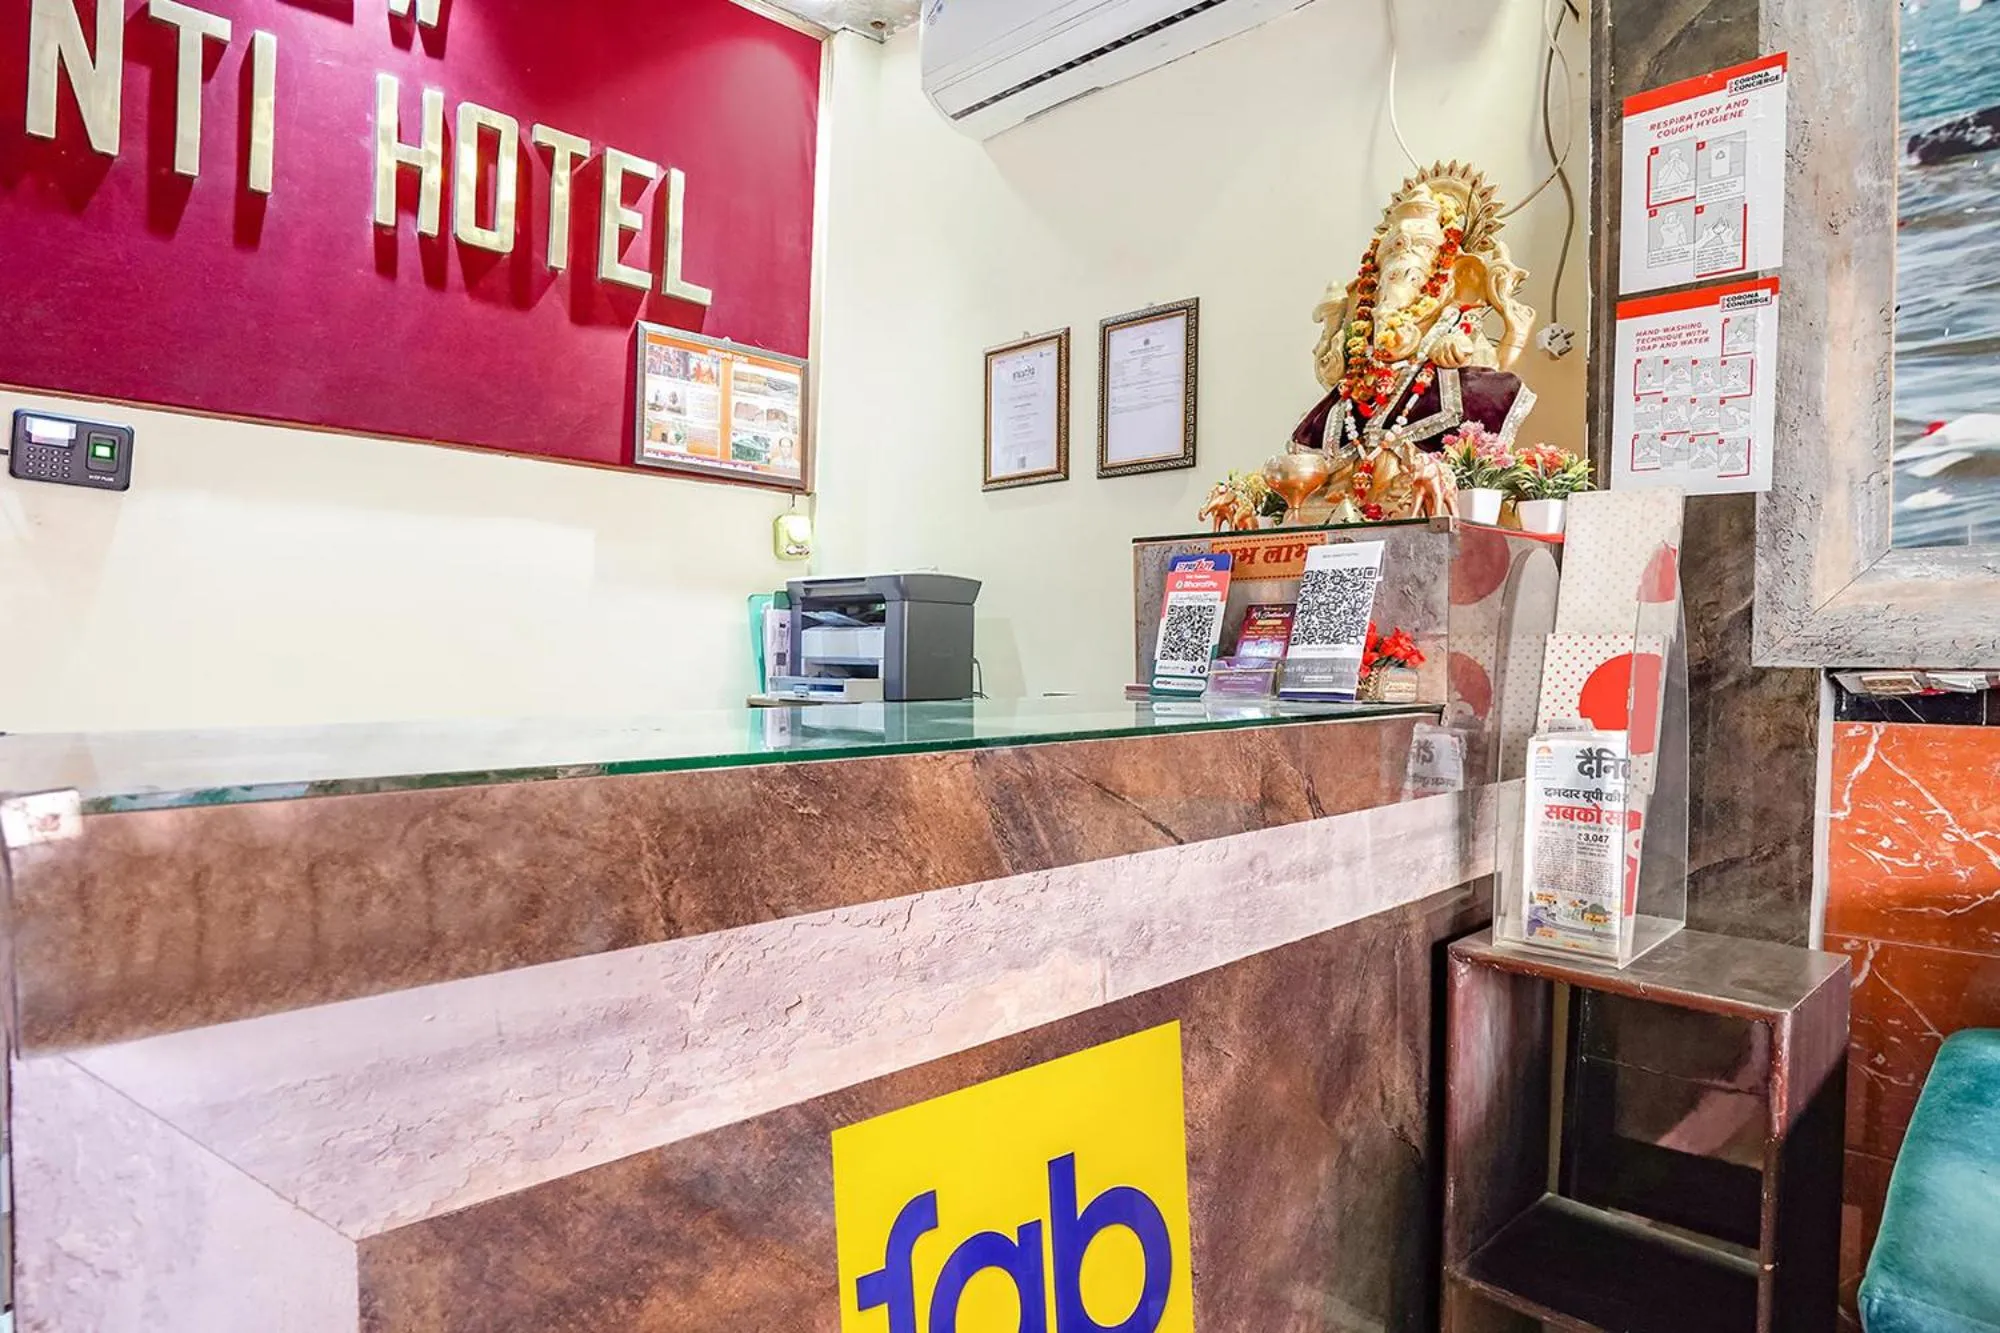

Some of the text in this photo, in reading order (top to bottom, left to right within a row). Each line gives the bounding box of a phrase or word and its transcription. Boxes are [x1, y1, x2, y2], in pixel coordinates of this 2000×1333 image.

[1734, 71, 1770, 86] CORONA
[1734, 74, 1780, 92] CONCIERGE
[1648, 98, 1749, 131] RESPIRATORY AND
[1656, 109, 1745, 139] COUGH HYGIENE
[25, 0, 713, 308] NTI HOTEL
[1726, 292, 1759, 302] CORONA
[1726, 296, 1769, 308] CONCIERGE
[1635, 337, 1710, 352] SOAP AND WATER
[1636, 328, 1709, 345] TECHNIQUE WITH
[1582, 788, 1603, 803] यूपी
[1544, 803, 1603, 824] सबको
[856, 1152, 1172, 1333] fab
